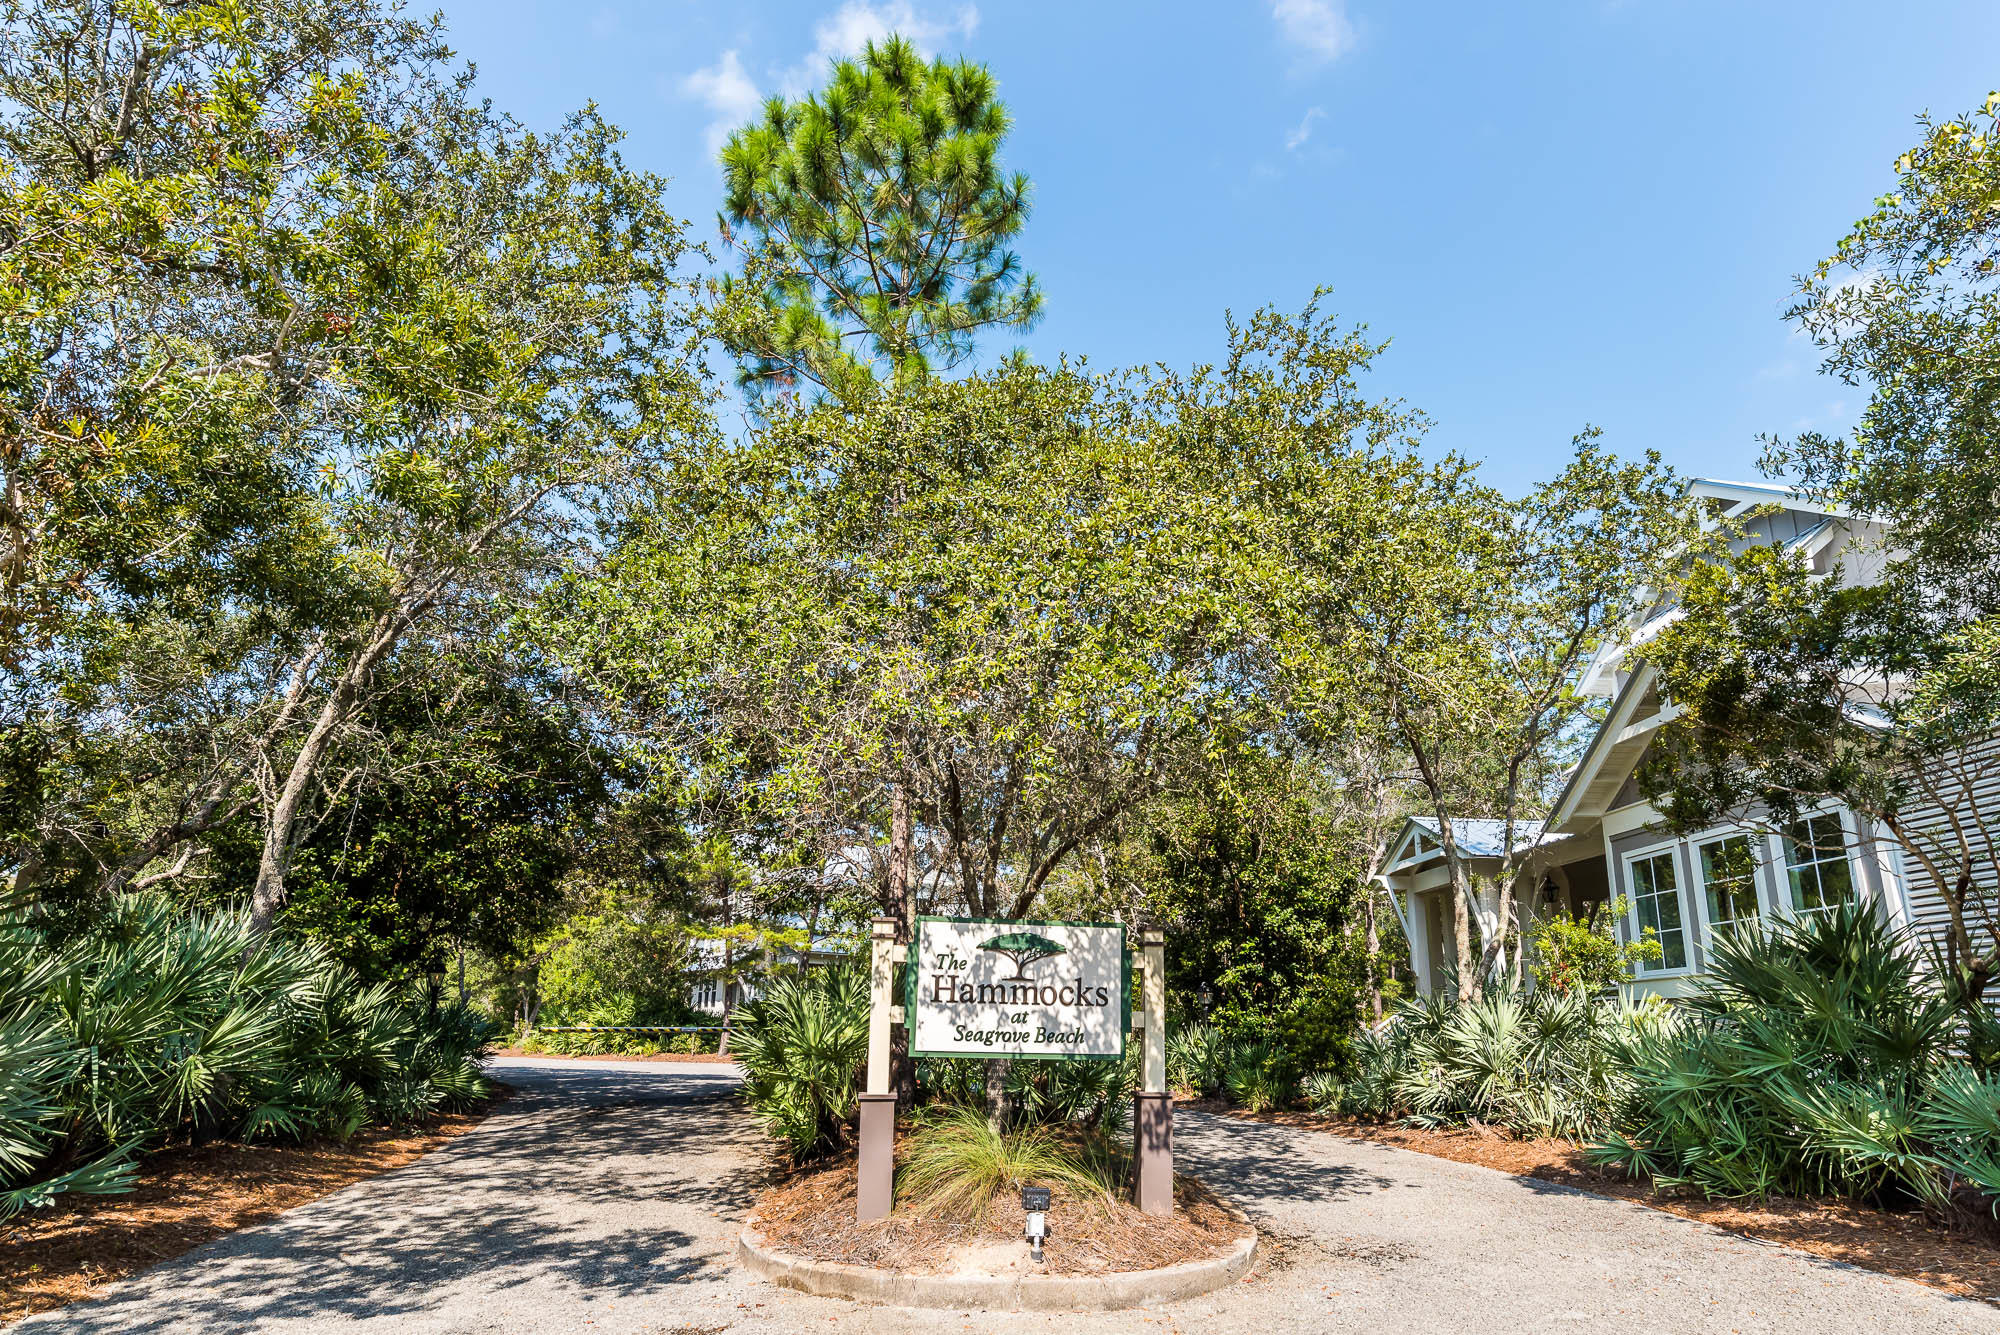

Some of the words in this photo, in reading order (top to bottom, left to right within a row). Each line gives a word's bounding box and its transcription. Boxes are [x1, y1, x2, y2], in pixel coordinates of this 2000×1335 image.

[936, 953, 967, 971] The
[931, 974, 1109, 1007] Hammocks
[1010, 1010, 1029, 1024] at
[953, 1025, 1030, 1046] Seagrove
[1034, 1027, 1085, 1044] Beach
